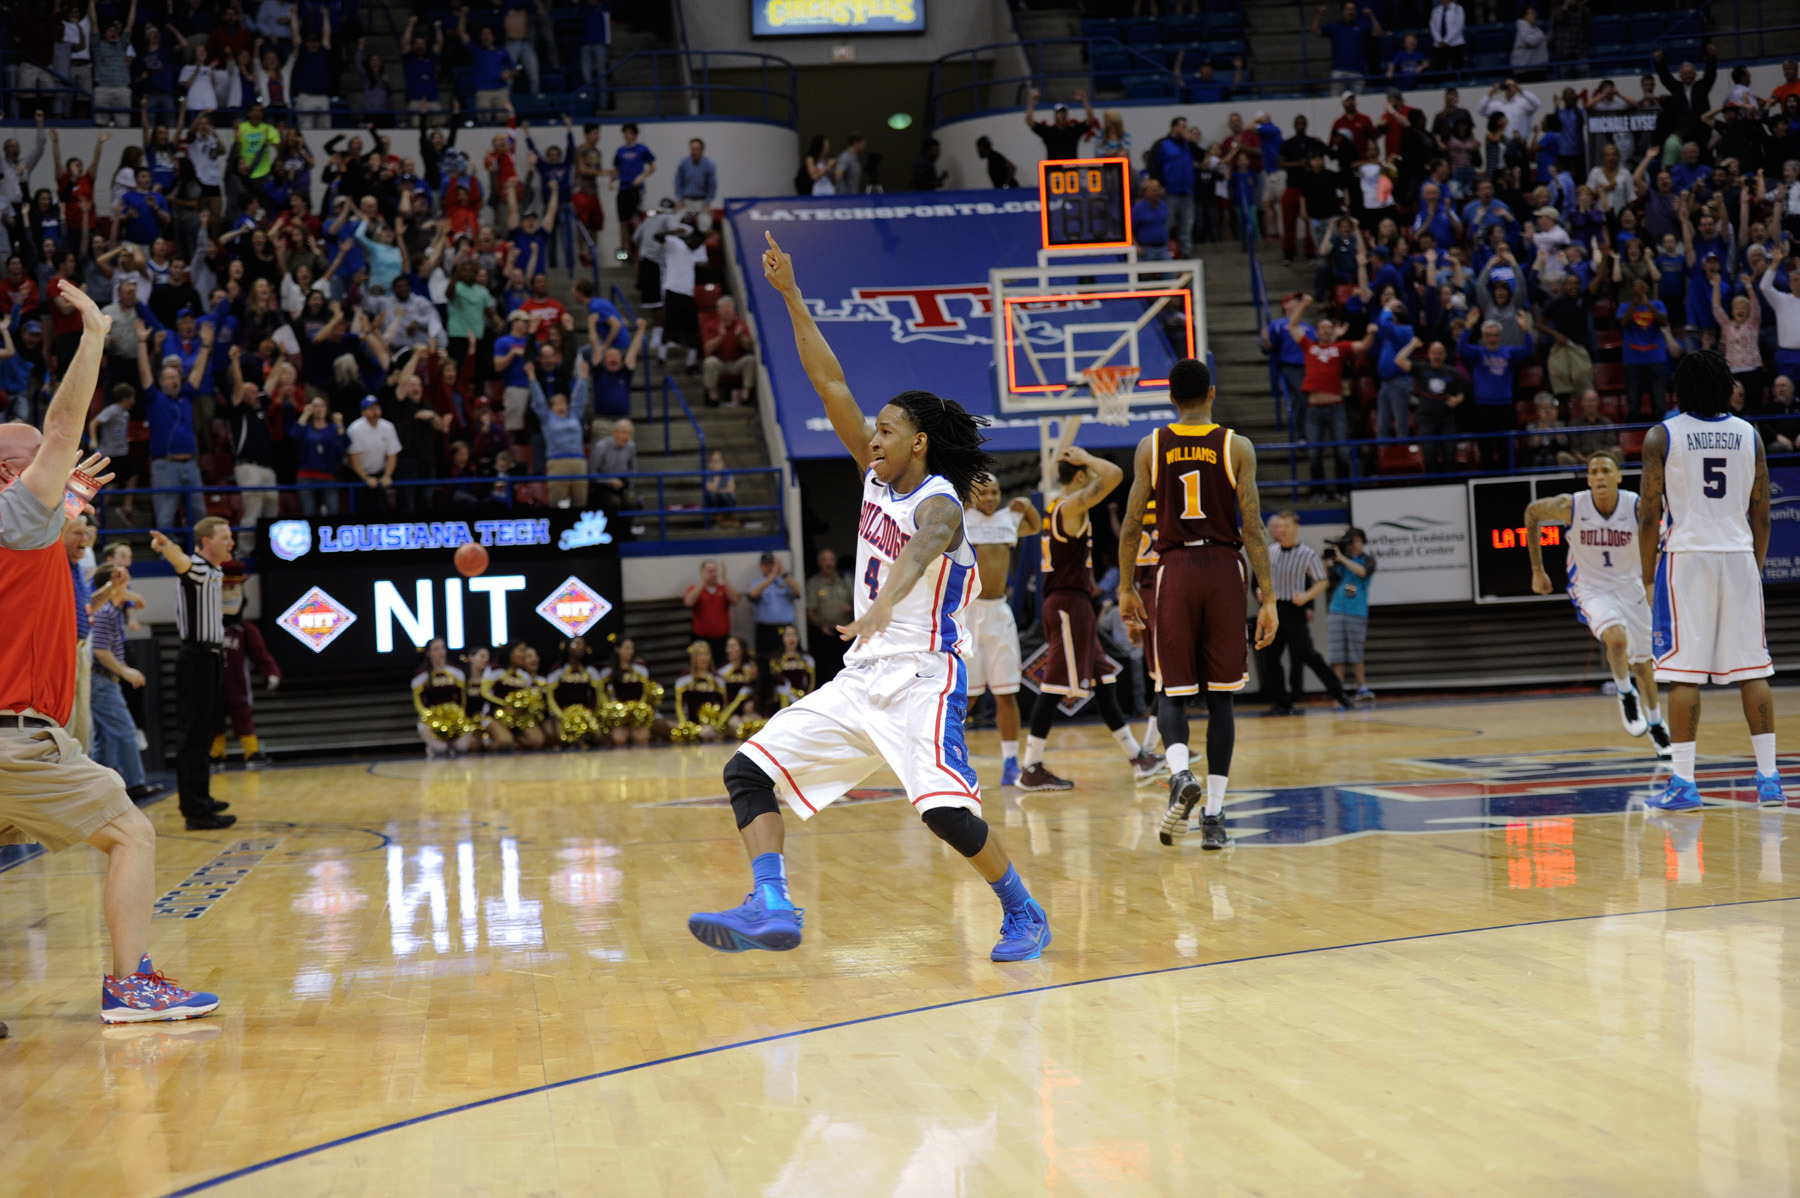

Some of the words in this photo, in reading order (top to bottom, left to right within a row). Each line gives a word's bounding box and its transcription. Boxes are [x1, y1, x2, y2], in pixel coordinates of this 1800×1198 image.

[1686, 431, 1743, 451] ANDERSON
[1165, 446, 1218, 465] WILLIAMS
[1702, 457, 1728, 499] 5
[1178, 469, 1207, 519] 1
[318, 521, 473, 552] LOUISIANA
[474, 518, 550, 546] TECH
[1516, 525, 1560, 547] TCH
[1580, 528, 1633, 548] BULLDOGS
[1602, 551, 1614, 567] 1
[864, 555, 882, 601] 4
[374, 575, 527, 653] NIT
